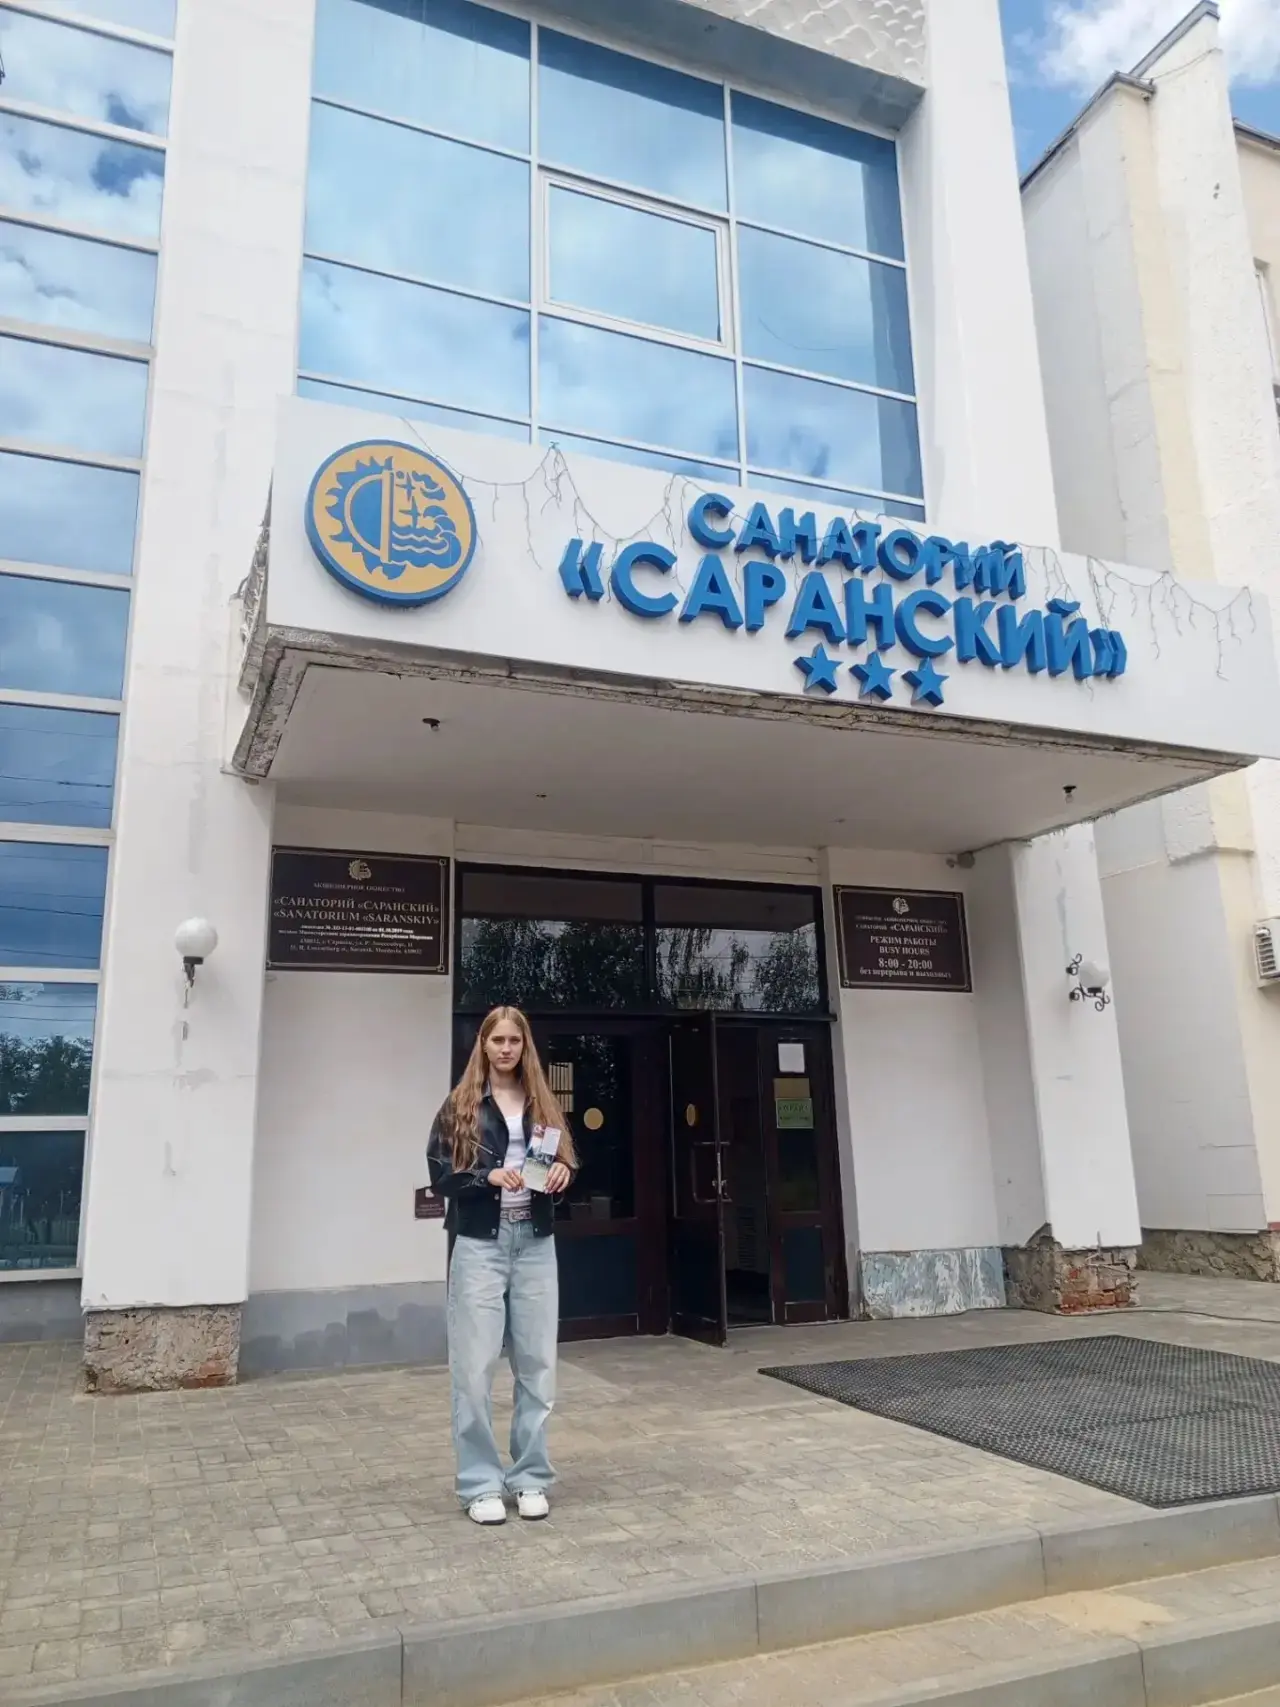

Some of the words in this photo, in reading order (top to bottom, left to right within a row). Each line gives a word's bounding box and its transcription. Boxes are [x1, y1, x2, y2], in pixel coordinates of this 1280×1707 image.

[688, 493, 1025, 600] САНАТОРИЙ
[558, 538, 1128, 681] «САРАНСКИЙ»
[274, 896, 355, 909] «САНАТОРИЙ
[357, 900, 440, 913] «САРАНСКИЙ»
[273, 908, 360, 921] «SANATORIUM
[362, 912, 440, 925] «SARANSKIY»
[870, 935, 902, 945] РЕЖИМ
[903, 937, 937, 946] РАБОТЫ
[879, 945, 900, 954] BUSY
[902, 946, 930, 956] HOURS
[878, 957, 899, 969] 8:00
[907, 959, 933, 970] 20:00
